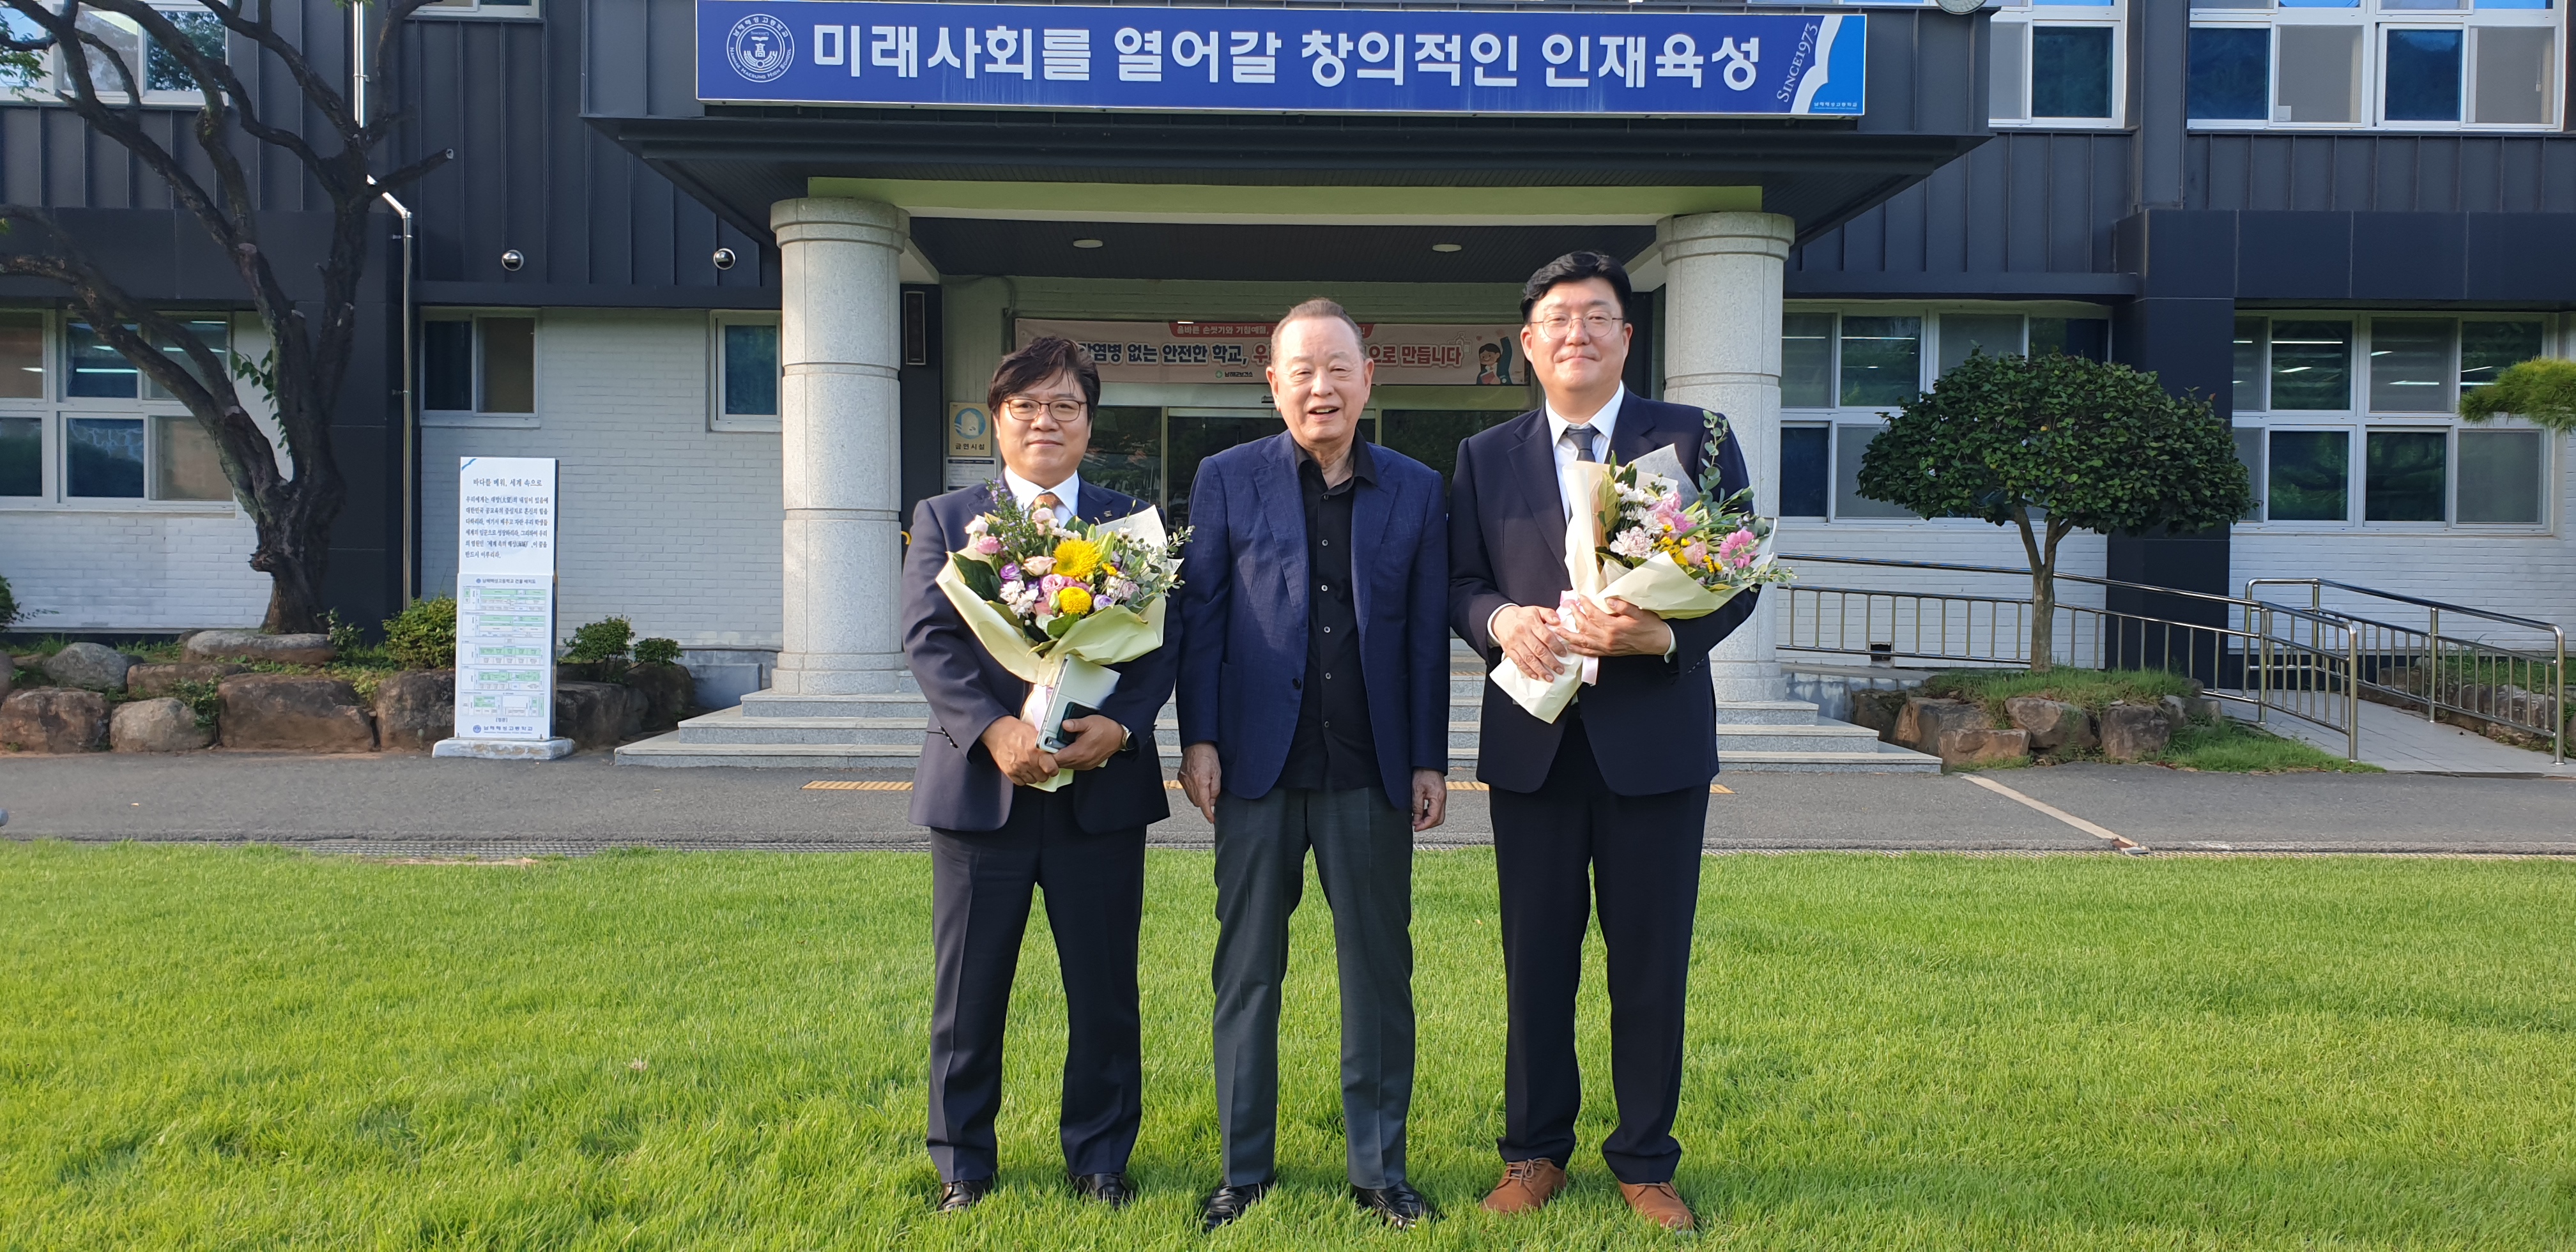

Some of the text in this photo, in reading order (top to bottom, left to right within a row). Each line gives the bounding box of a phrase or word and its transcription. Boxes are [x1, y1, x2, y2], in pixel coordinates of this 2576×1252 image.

[815, 25, 1759, 91] 미래사회를 열어갈 창의적인 인재육성
[1777, 22, 1818, 103] SINCE1973
[1202, 326, 1233, 335] 손씻기와
[1236, 326, 1269, 335] 기침예절,
[1128, 344, 1158, 362] 없는
[1162, 344, 1208, 363] 안전한
[1212, 344, 1246, 365] 학교,
[1401, 346, 1461, 364] 만듭니다
[473, 478, 491, 486] 바다를
[510, 478, 522, 487] 세계
